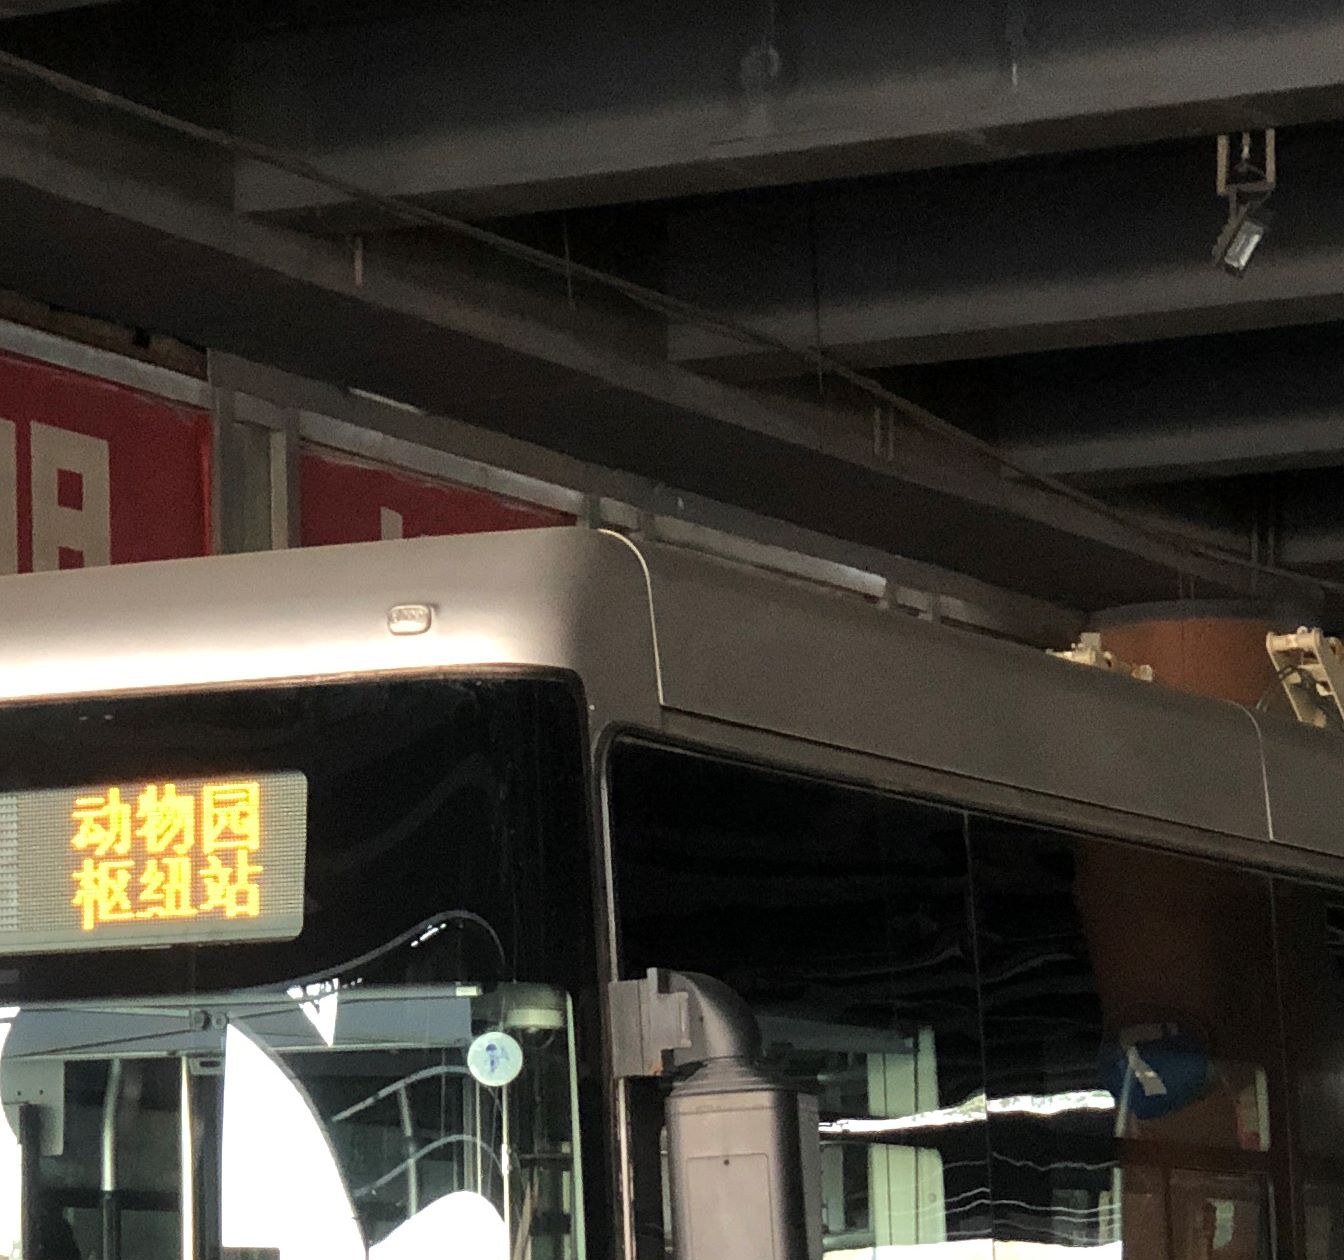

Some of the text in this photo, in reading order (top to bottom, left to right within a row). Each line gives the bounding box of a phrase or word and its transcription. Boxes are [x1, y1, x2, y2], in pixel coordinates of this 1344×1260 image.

[72, 782, 260, 858] 动物园
[72, 853, 262, 930] 枢纽站
